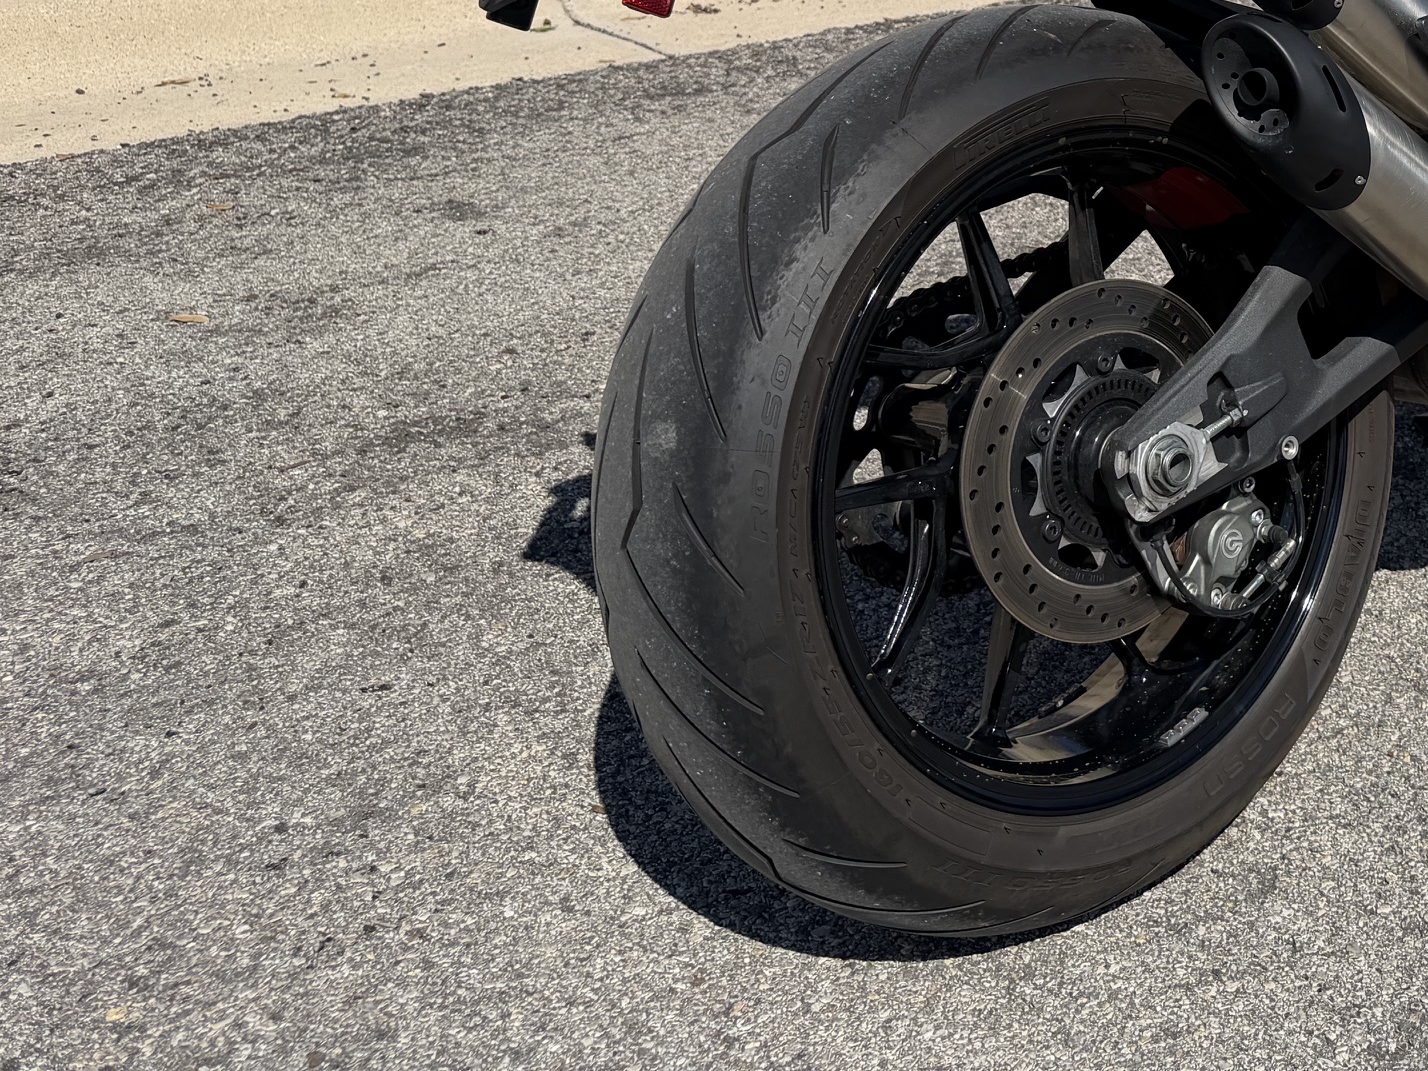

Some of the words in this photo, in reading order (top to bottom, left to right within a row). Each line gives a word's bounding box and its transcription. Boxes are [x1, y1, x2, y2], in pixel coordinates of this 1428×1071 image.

[951, 97, 1051, 171] PIRELLI
[750, 354, 792, 541] ROSSO
[1314, 498, 1372, 651] DIABLO
